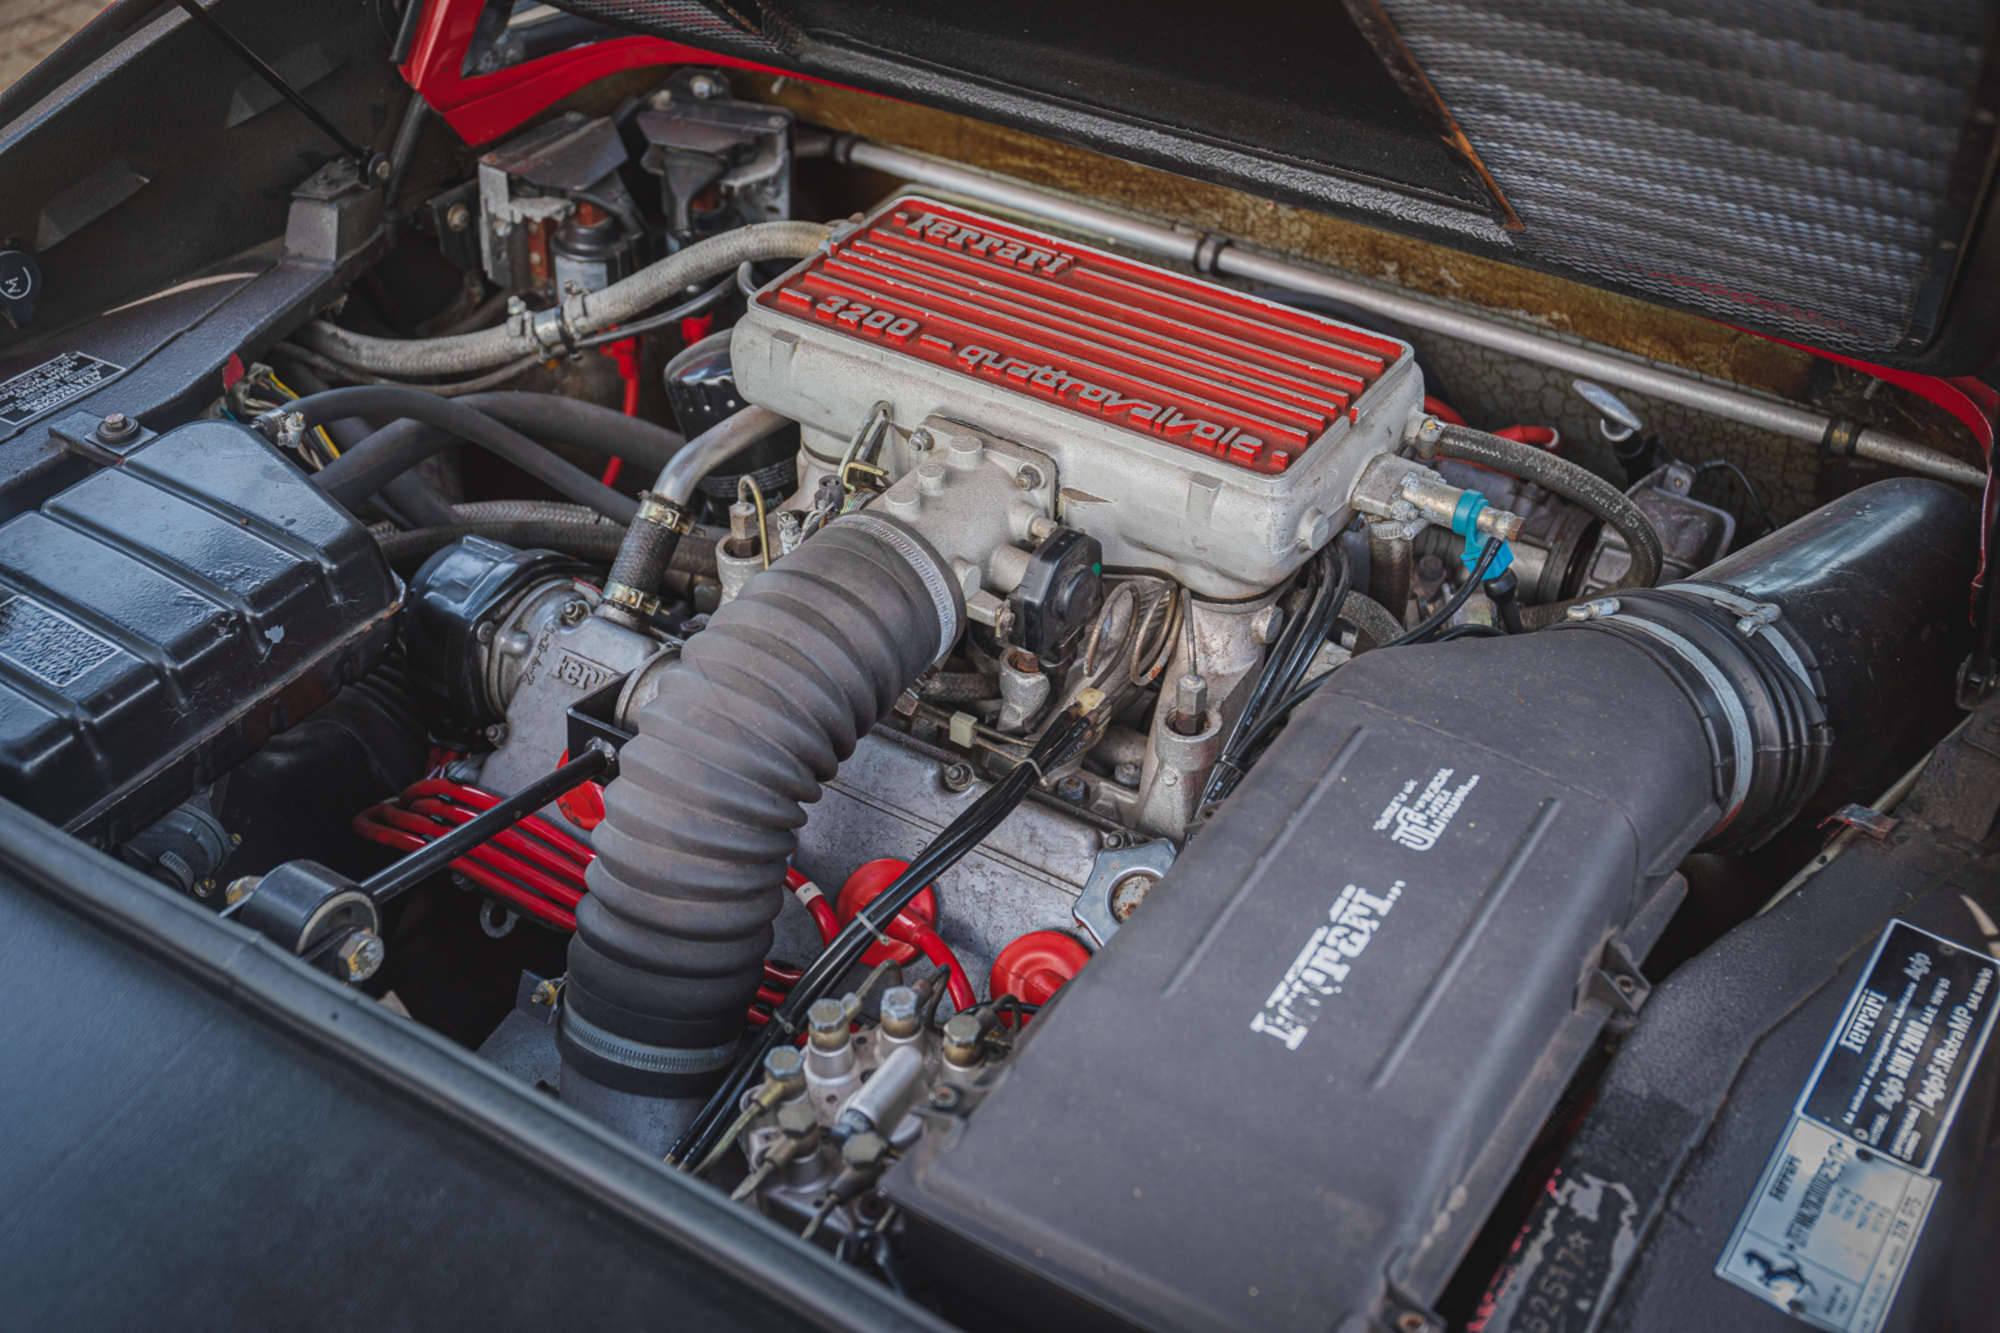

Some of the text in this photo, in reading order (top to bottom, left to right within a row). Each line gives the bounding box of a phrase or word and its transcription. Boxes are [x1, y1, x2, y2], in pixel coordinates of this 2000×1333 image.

[905, 212, 1074, 275] Ferrari
[815, 295, 1264, 460] 3200 quattrovalvole
[1903, 952, 1932, 981] Agip
[1839, 989, 1888, 1054] Ferrari
[1898, 1019, 1930, 1054] 2000
[1886, 1050, 1917, 1079] SINT
[1915, 1076, 1947, 1108] Agip
[1947, 1005, 1974, 1032] MP
[1873, 1076, 1906, 1111] Agip
